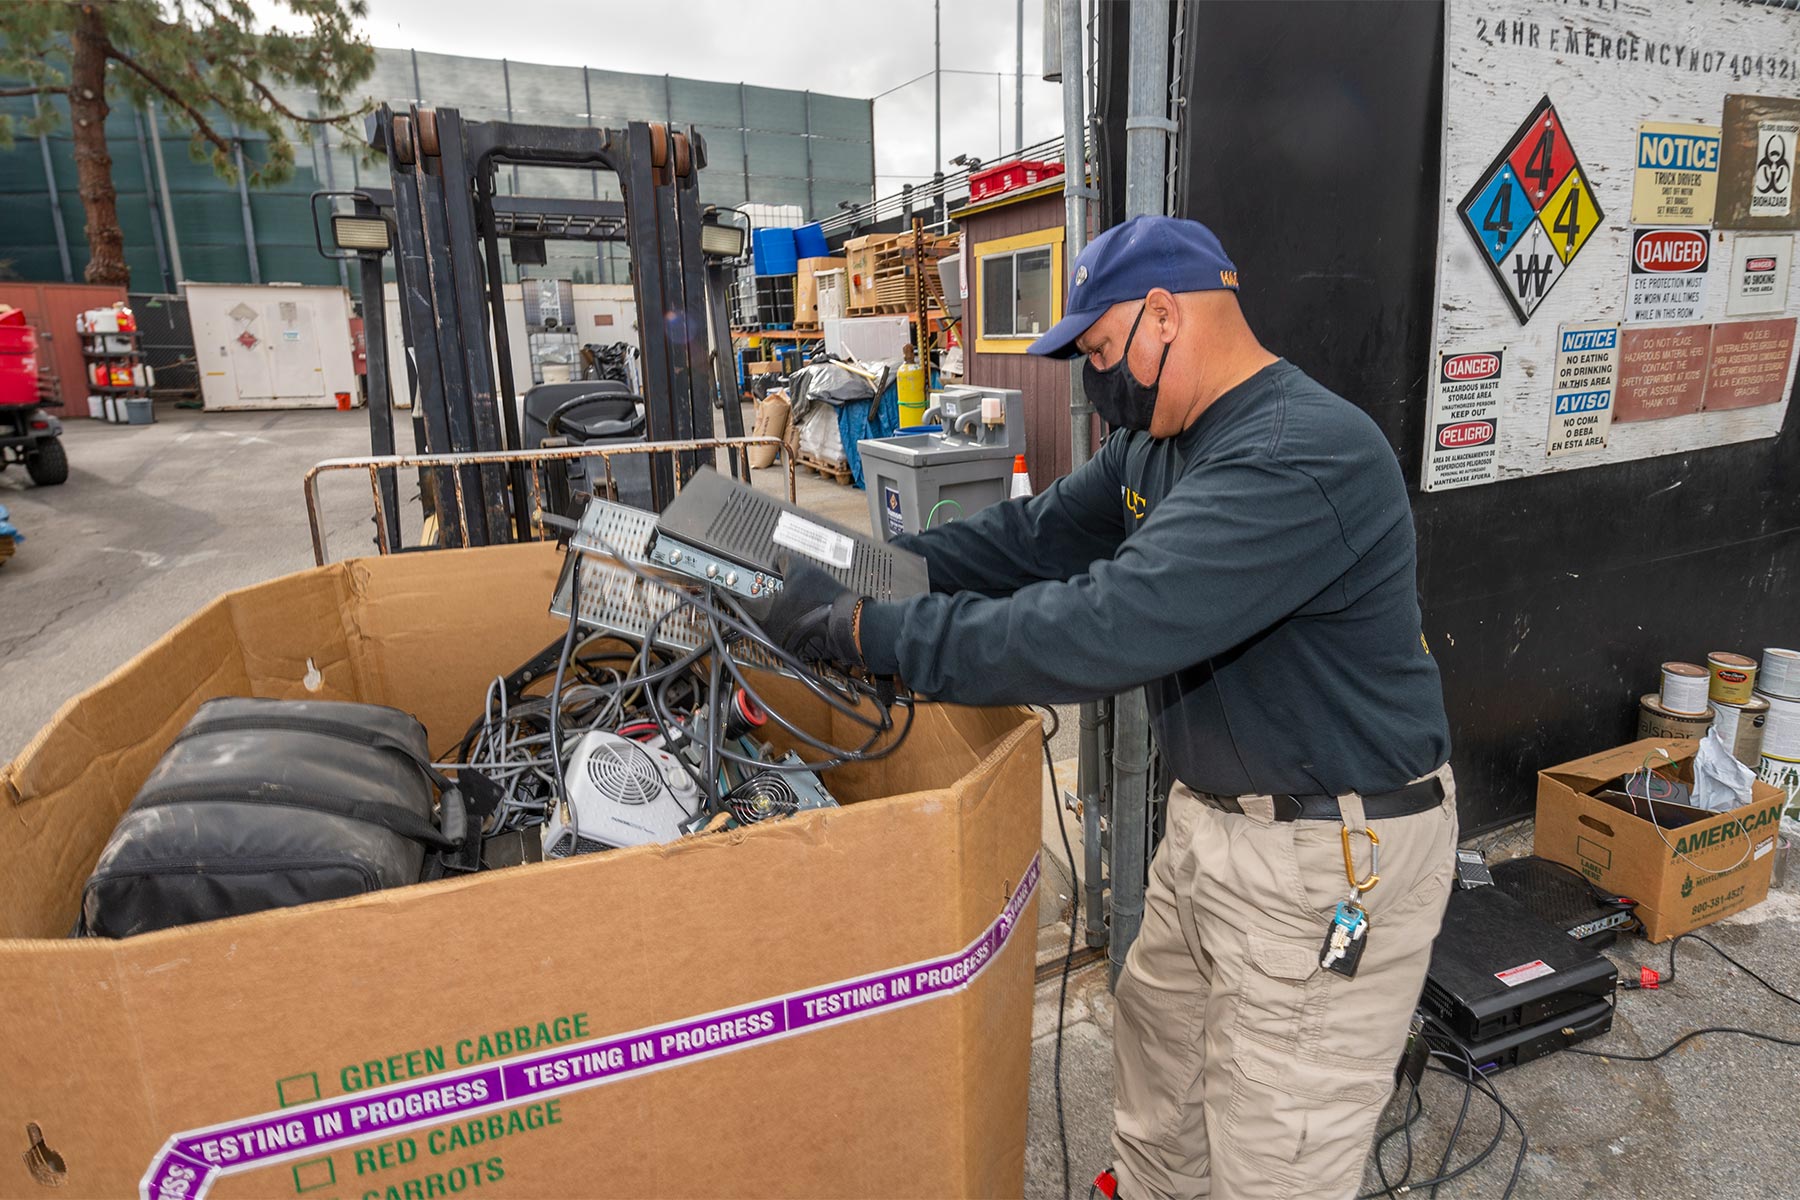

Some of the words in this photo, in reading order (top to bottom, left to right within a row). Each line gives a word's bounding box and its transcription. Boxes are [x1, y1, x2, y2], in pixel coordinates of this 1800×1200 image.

[1524, 128, 1555, 191] 4
[1640, 136, 1718, 169] NOTICE
[1654, 171, 1676, 186] TRUCK
[1677, 172, 1702, 187] DRIVERS
[1753, 196, 1788, 207] BIOHAZARD
[1483, 183, 1513, 244] 4
[1553, 187, 1581, 247] 4
[1641, 240, 1703, 263] DANGER
[1634, 278, 1647, 289] EYE
[1648, 277, 1684, 289] PROTECTION
[1685, 277, 1703, 288] MUST
[1743, 274, 1751, 286] NO
[1752, 274, 1775, 285] SMOKING
[1633, 293, 1643, 305] BE
[1644, 293, 1661, 303] WORN
[1662, 292, 1670, 303] AT
[1670, 292, 1681, 303] ALL
[1683, 291, 1700, 302] TIMES
[1635, 309, 1654, 320] WHILE
[1655, 309, 1662, 319] IN
[1663, 308, 1676, 319] THIS
[1676, 307, 1694, 318] ROOM
[1563, 330, 1616, 351] NOTICE
[1643, 339, 1654, 349] DO
[1655, 337, 1671, 348] NOT
[1672, 335, 1693, 347] PLACE
[1566, 355, 1578, 365] NO
[1580, 353, 1609, 364] EATING
[1624, 350, 1661, 363] HAZARDOUS
[1662, 348, 1688, 360] MATERIAL
[1447, 357, 1497, 377] DANGER
[1560, 368, 1572, 378] OR
[1574, 364, 1612, 376] DRINKING
[1641, 361, 1674, 373] CONTACT
[1676, 359, 1688, 370] THE
[1442, 383, 1479, 394] HAZARDOUS
[1480, 381, 1499, 391] WASTE
[1559, 380, 1568, 389] IN
[1570, 378, 1588, 388] THIS
[1590, 376, 1611, 387] AREA
[1621, 375, 1643, 388] SAFETY
[1643, 372, 1676, 385] DEPARTMENT
[1720, 379, 1729, 388] LA
[1448, 392, 1475, 402] STORAGE
[1476, 391, 1492, 400] AREA
[1633, 387, 1648, 398] FOR
[1650, 382, 1688, 397] ASSISTANCE
[1441, 401, 1476, 411] UNAUTHORIZED
[1476, 400, 1497, 408] PERSONS
[1557, 391, 1610, 414] AVISO
[1641, 398, 1664, 409] THANK
[1450, 409, 1470, 419] KEEP
[1471, 408, 1486, 418] OUT
[1563, 418, 1575, 428] NO
[1576, 415, 1598, 427] COMA
[1442, 425, 1491, 444] PELIGRO
[1566, 429, 1572, 438] O
[1574, 427, 1593, 437] BEBA
[1552, 442, 1562, 451] EN
[1564, 439, 1583, 449] ESTA
[1584, 436, 1604, 447] AREA
[1445, 454, 1451, 462] DE
[1451, 450, 1489, 461] ALMACENAMIENTO
[1490, 449, 1496, 457] DE
[1435, 461, 1466, 472] DESPERDICIOS
[1466, 457, 1492, 468] PELIGROSOS
[1470, 472, 1491, 480] AFUERA
[1672, 803, 1783, 859] AMERICAN
[1580, 858, 1604, 877] LABEL
[802, 982, 887, 1019] TESTING
[891, 976, 912, 997] IN
[340, 1044, 446, 1093] GREEN
[455, 1012, 590, 1066] CABBAGE
[523, 1046, 626, 1088] TESTING
[631, 1039, 655, 1063] IN
[660, 1010, 776, 1056] PROGRESS
[313, 1111, 343, 1140] IN
[351, 1077, 489, 1130] PROGRESS
[354, 1136, 418, 1176] RED
[427, 1098, 564, 1156] CABBAGE
